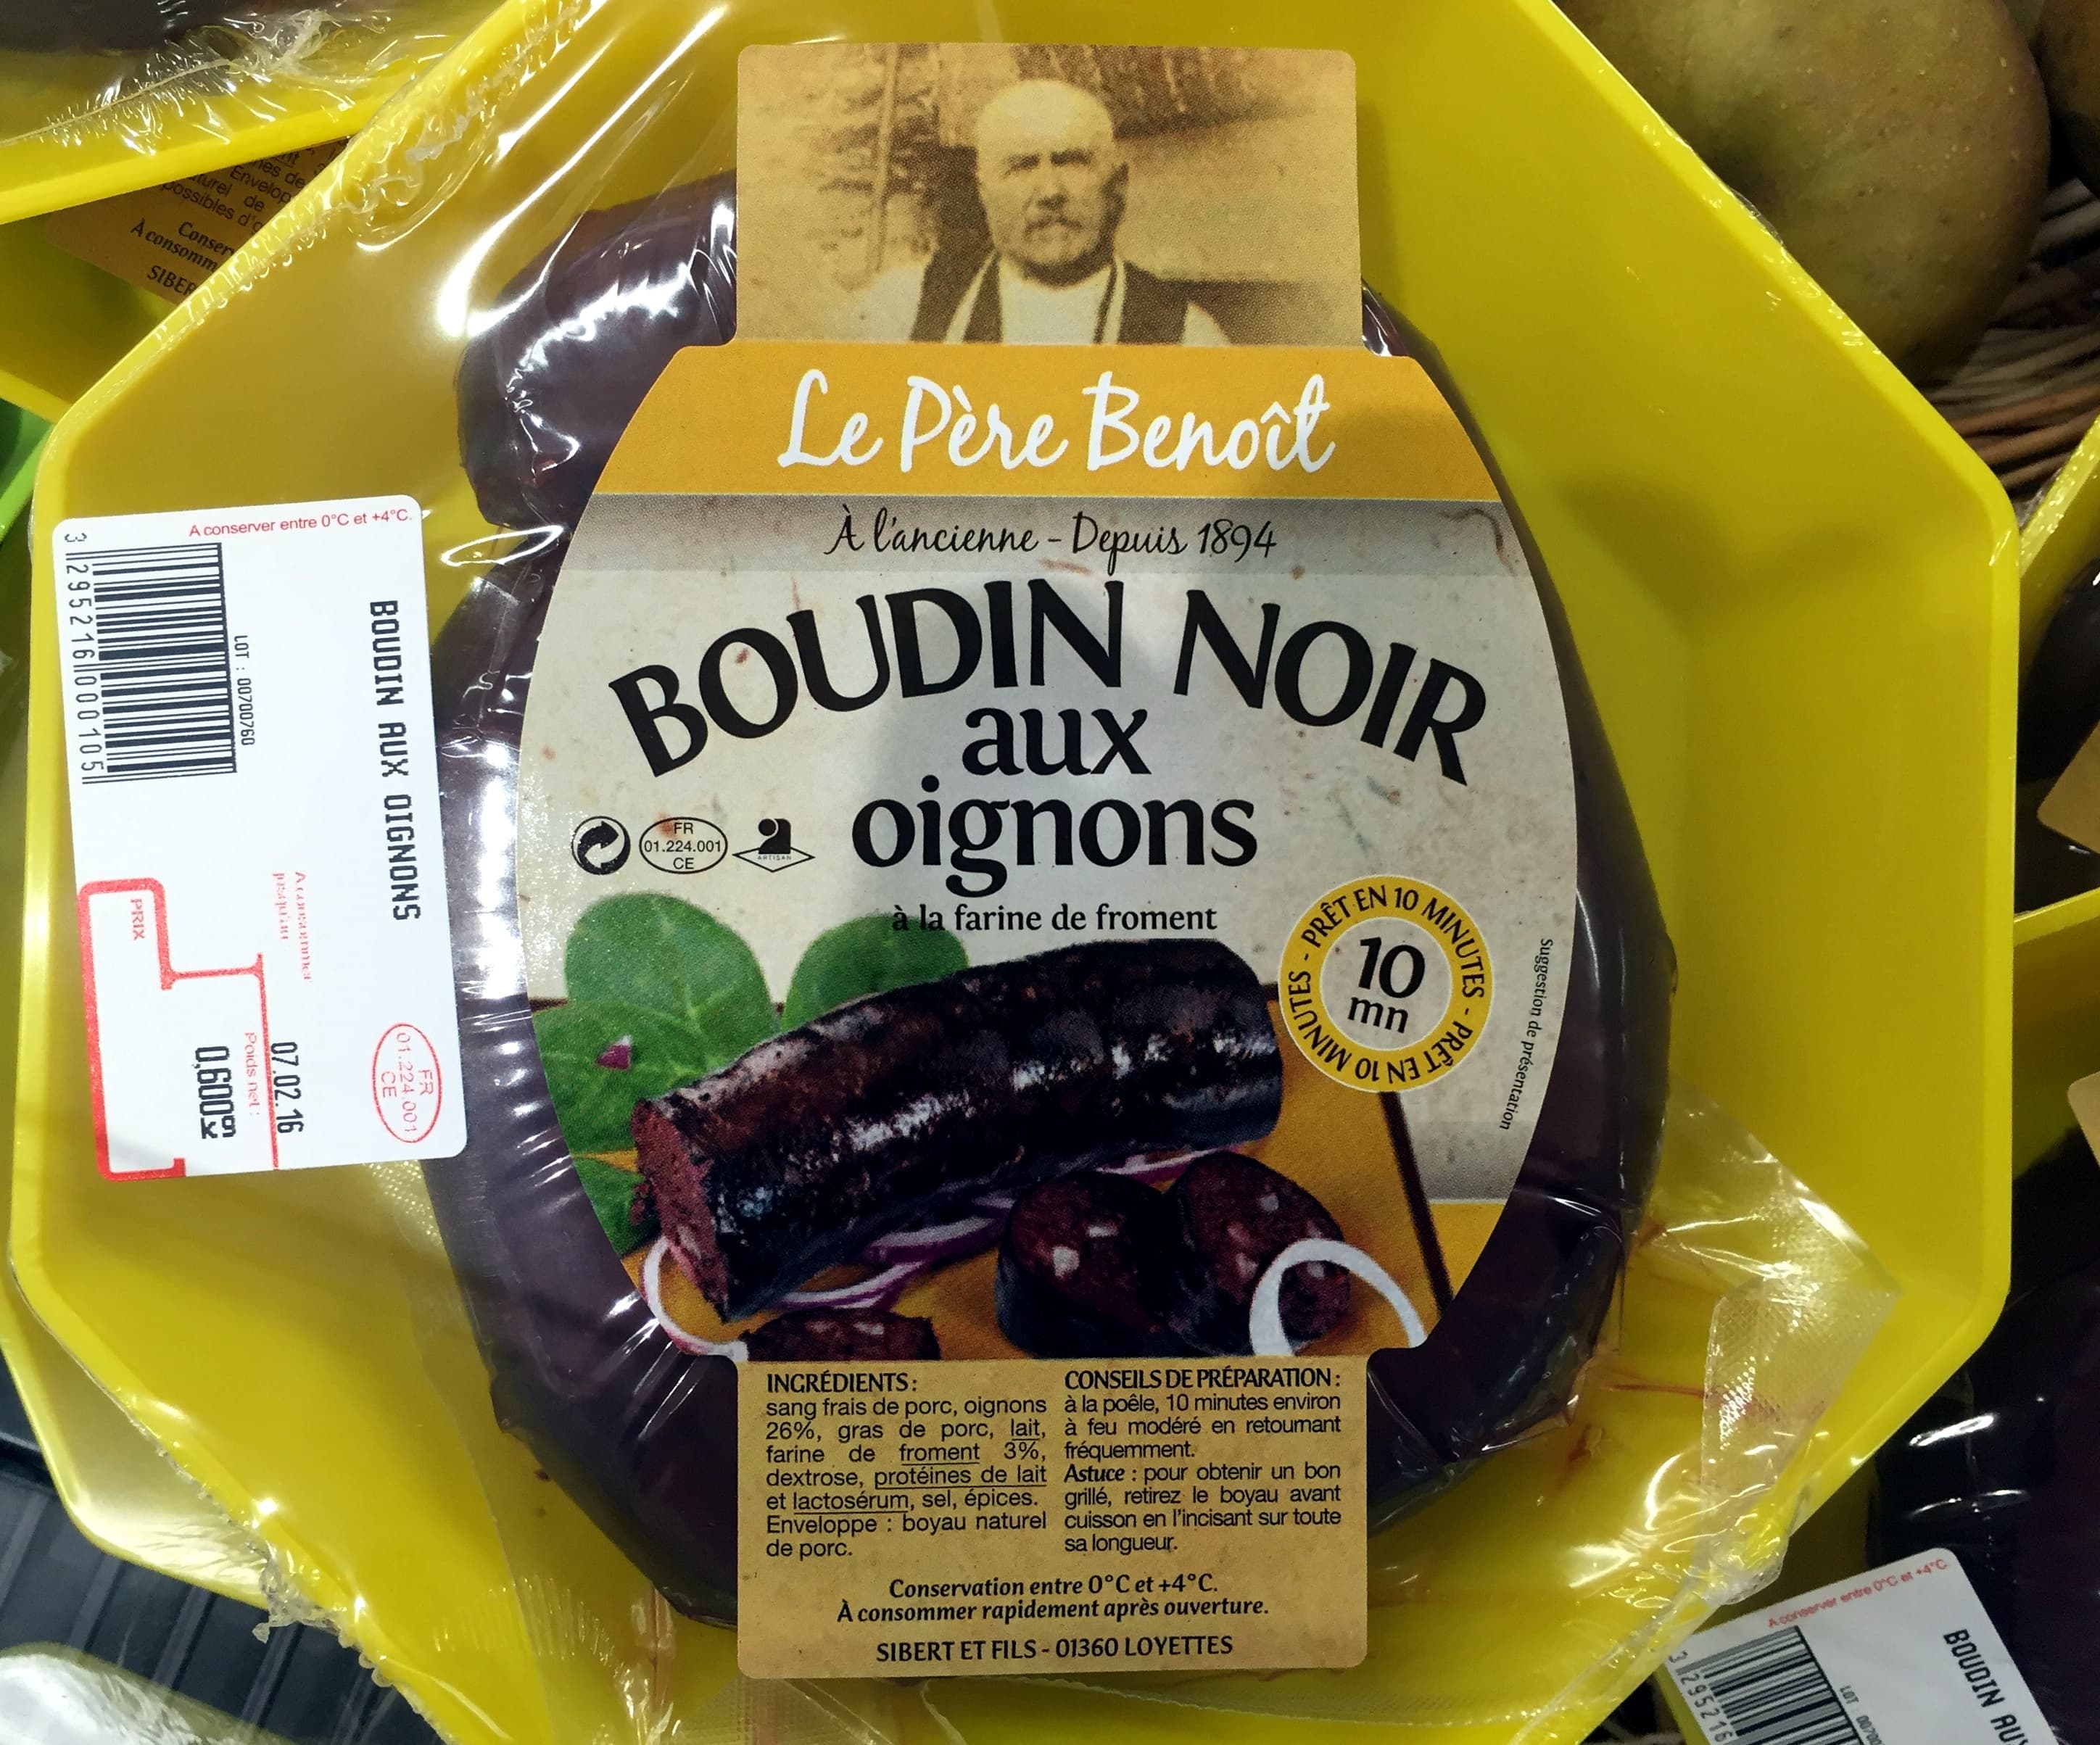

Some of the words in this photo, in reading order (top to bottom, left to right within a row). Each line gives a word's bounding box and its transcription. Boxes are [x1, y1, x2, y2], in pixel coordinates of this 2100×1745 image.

[230, 165, 292, 205] Envelop
[244, 194, 265, 212] de
[146, 232, 218, 273] consomm
[147, 265, 196, 296] SIBER
[777, 368, 883, 468] Le
[900, 375, 1068, 473] Père
[1082, 370, 1337, 473] Benoît
[189, 525, 201, 537] A
[204, 521, 275, 536] conserver
[280, 518, 317, 530] entre
[321, 513, 349, 527] 0°C
[353, 513, 367, 524] et
[824, 504, 865, 556] À
[873, 507, 1039, 553] l'ancienne
[1073, 512, 1189, 576] Depuis
[1199, 521, 1278, 561] 1894
[234, 635, 249, 658] LOT
[370, 600, 404, 705] BOUDIN
[609, 579, 1123, 777] BOUDIN
[1173, 589, 1487, 786] NOIR
[236, 678, 255, 745] 00700760
[378, 722, 409, 777] AUX
[962, 707, 1152, 776] aux
[674, 822, 694, 834] FR
[851, 774, 1257, 898] oignons
[384, 794, 421, 921] OIGNONS
[644, 840, 721, 853] 01.224.001
[673, 858, 694, 869] CE
[130, 899, 146, 941] PRIX
[892, 905, 909, 930] à
[918, 905, 943, 930] la
[954, 903, 1042, 931] farine
[1051, 904, 1086, 930] de
[1096, 903, 1218, 931] froment
[1302, 896, 1349, 948] PRÊT
[1356, 885, 1387, 912] EN
[1394, 887, 1419, 911] 10
[1421, 897, 1485, 998] MINUTES
[1359, 937, 1426, 998] 10
[1531, 938, 1553, 1017] Suggestion
[1289, 971, 1352, 1072] MINUTES
[1347, 996, 1409, 1034] mn
[1527, 1019, 1542, 1037] de
[245, 1032, 258, 1077] Poids
[1423, 1019, 1473, 1074] PRÊT
[397, 1032, 417, 1132] 01.224.001
[418, 1069, 434, 1095] FR
[1355, 1058, 1380, 1082] 10
[1387, 1056, 1421, 1084] EN
[247, 1084, 260, 1107] net
[270, 1042, 304, 1134] 07.02.16
[381, 1072, 397, 1098] CE
[1500, 1040, 1534, 1130] présentation
[1065, 1369, 1162, 1390] CONSEILS
[1165, 1369, 1193, 1388] DE
[766, 1402, 817, 1419] sang
[823, 1398, 867, 1415] frais
[872, 1398, 898, 1415] de
[906, 1399, 958, 1420] porc,
[964, 1398, 1047, 1419] oignons
[1065, 1396, 1076, 1412] à
[1083, 1396, 1096, 1412] la
[1104, 1393, 1159, 1416] poêle,
[1167, 1394, 1189, 1410] 10
[1195, 1394, 1268, 1410] minutes
[1273, 1393, 1341, 1409] environ
[766, 1421, 822, 1441] 26%,
[838, 1425, 883, 1443] gras
[899, 1422, 925, 1438] de
[941, 1422, 993, 1441] porc,
[1011, 1418, 1046, 1441] lait,
[1065, 1420, 1077, 1435] à
[1088, 1419, 1116, 1435] feu
[1128, 1417, 1201, 1435] modéré
[1212, 1420, 1235, 1434] en
[1246, 1416, 1341, 1433] retournant
[766, 1445, 825, 1463] farine
[849, 1446, 875, 1462] de
[900, 1443, 980, 1465] froment
[1004, 1443, 1046, 1462] 3%,
[1064, 1441, 1195, 1462] fréquemment.
[766, 1469, 864, 1488] dextrose,
[875, 1467, 971, 1489] protéines
[980, 1466, 1006, 1483] de
[1017, 1465, 1047, 1483] lait
[1064, 1464, 1124, 1483] Astuce
[1144, 1466, 1188, 1485] pour
[1197, 1463, 1262, 1480] obtenir
[1271, 1466, 1294, 1480] un
[1305, 1462, 1341, 1479] bon
[766, 1493, 785, 1509] et
[793, 1491, 914, 1514] lactosérum,
[922, 1490, 957, 1509] sel,
[964, 1489, 1038, 1512] épices.
[1065, 1488, 1112, 1509] grillé,
[1124, 1488, 1181, 1504] retirez
[1193, 1486, 1208, 1503] le
[1220, 1485, 1278, 1506] boyau
[1290, 1485, 1341, 1501] avant
[767, 1516, 877, 1537] Enveloppe
[903, 1514, 965, 1535] boyau
[976, 1512, 1046, 1530] naturel
[1065, 1512, 1136, 1529] cuisson
[1144, 1513, 1166, 1527] en
[1173, 1509, 1253, 1527] l'incisant
[1258, 1512, 1287, 1525] sur
[1294, 1508, 1342, 1525] toute
[766, 1541, 792, 1557] de
[799, 1542, 852, 1561] porc.
[1065, 1538, 1087, 1551] sa
[1092, 1535, 1178, 1555] longueur.
[888, 1578, 1024, 1599] Conservation
[1029, 1578, 1083, 1596] entre
[1088, 1575, 1130, 1594] 0°C
[1135, 1575, 1154, 1593] et
[1159, 1572, 1219, 1595] +4°C.
[837, 1599, 853, 1622] À
[858, 1604, 974, 1622] consommer
[982, 1600, 1099, 1625] rapidement
[1104, 1598, 1159, 1622] après
[1164, 1599, 1269, 1617] ouverture.
[876, 1641, 956, 1662] SIBERT
[961, 1641, 988, 1659] ET
[992, 1639, 1037, 1659] FILS
[1055, 1638, 1118, 1658] 01360
[1125, 1636, 1233, 1657] LOYETTES
[1943, 1628, 2005, 1707] BOUDIN
